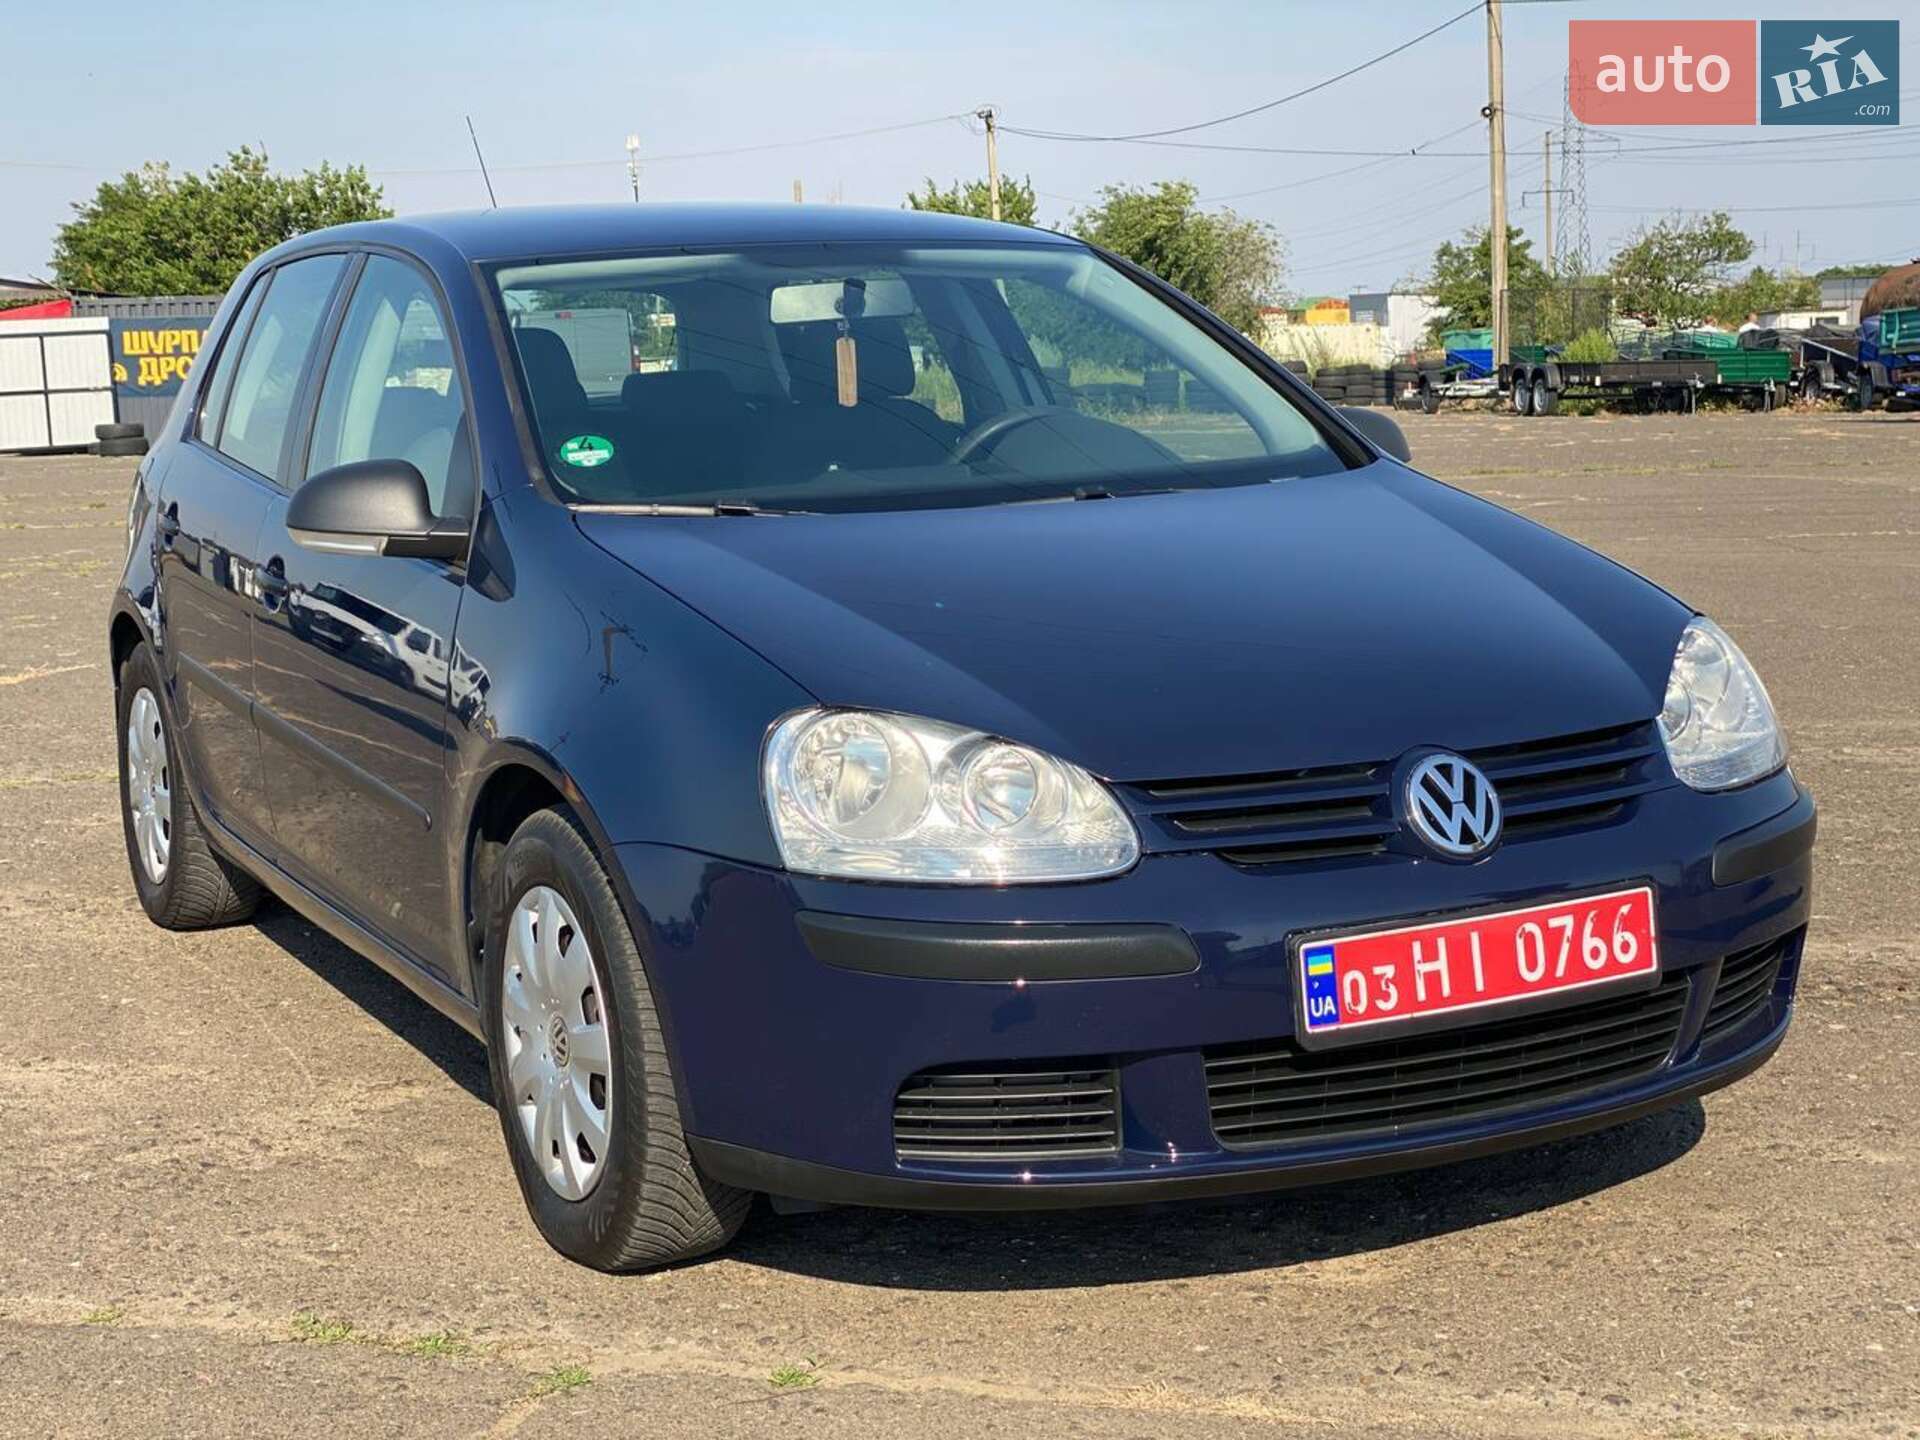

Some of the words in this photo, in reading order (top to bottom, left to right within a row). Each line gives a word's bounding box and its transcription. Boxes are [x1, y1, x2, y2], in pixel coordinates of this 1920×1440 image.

[1342, 963, 1399, 1016] 03
[1514, 903, 1638, 983] 0766
[1310, 995, 1337, 1018] UA
